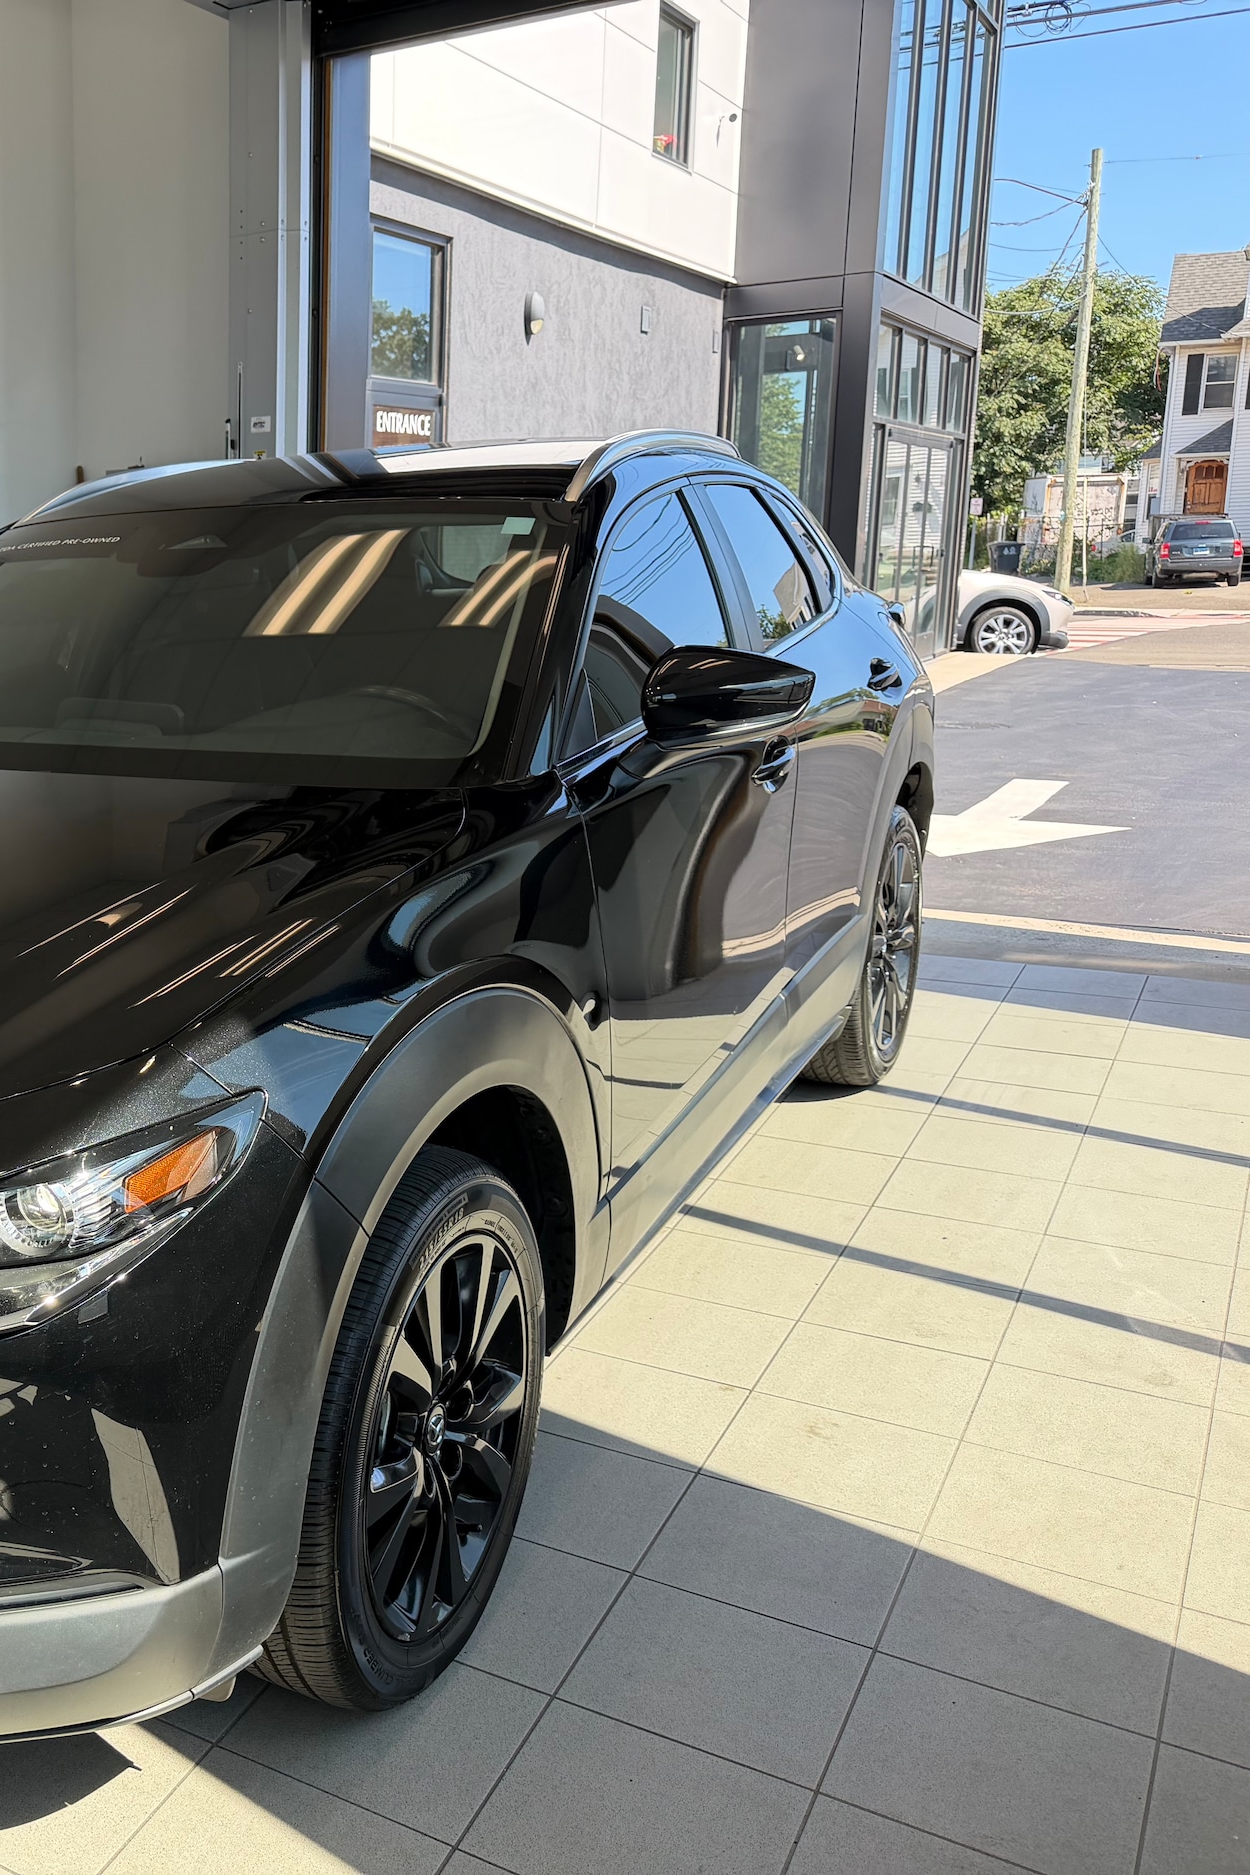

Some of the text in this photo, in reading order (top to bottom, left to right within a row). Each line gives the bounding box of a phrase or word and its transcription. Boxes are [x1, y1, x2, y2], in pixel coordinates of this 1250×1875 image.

[376, 410, 431, 436] ENTRANCE
[16, 540, 61, 550] CERTIFIED
[61, 536, 121, 546] PRE-OWNED
